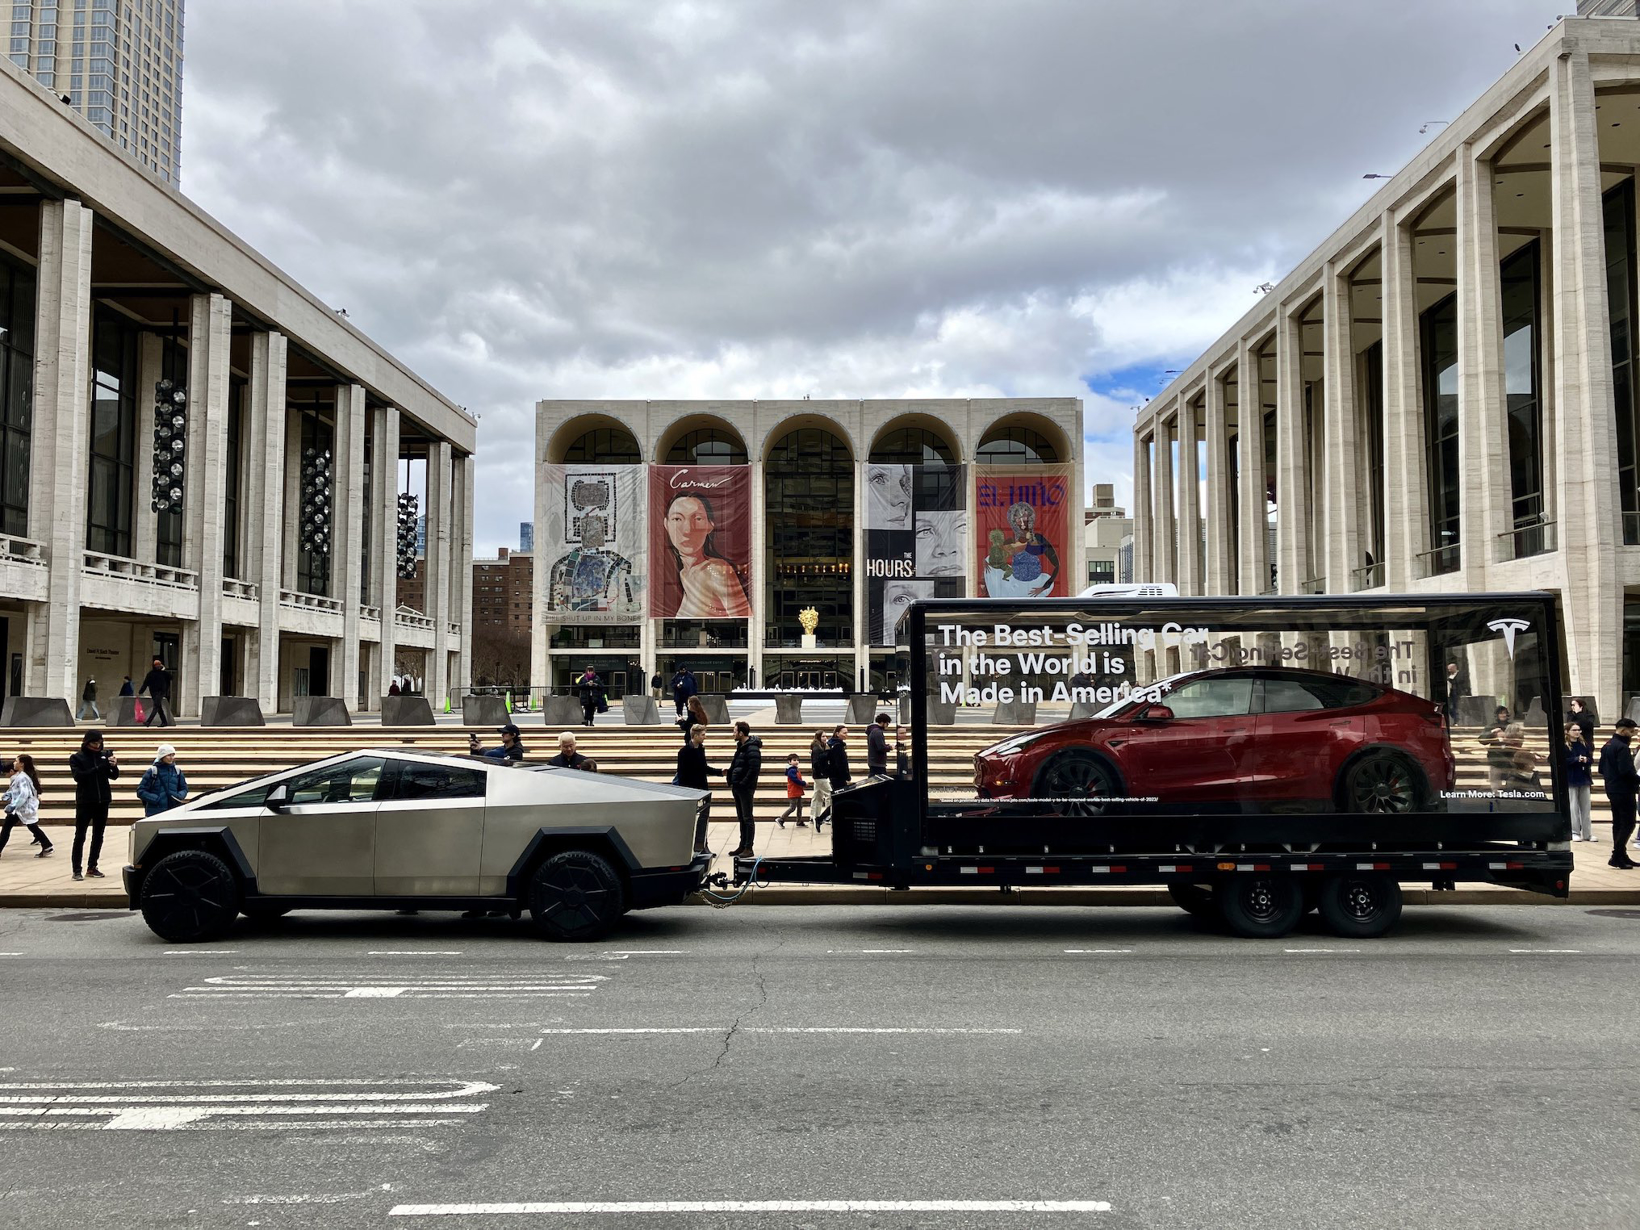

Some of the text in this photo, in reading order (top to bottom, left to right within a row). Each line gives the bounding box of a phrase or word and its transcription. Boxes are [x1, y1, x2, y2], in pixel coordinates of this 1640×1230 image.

[670, 469, 734, 489] Carmen
[979, 484, 1004, 507] EL
[866, 558, 913, 578] HOURS
[938, 622, 1209, 650] The Best-Selling Car
[939, 651, 1125, 675] in the World is
[940, 681, 1014, 704] Made
[1021, 681, 1043, 704] in
[1440, 789, 1545, 799] Learn More: Tesla.com
